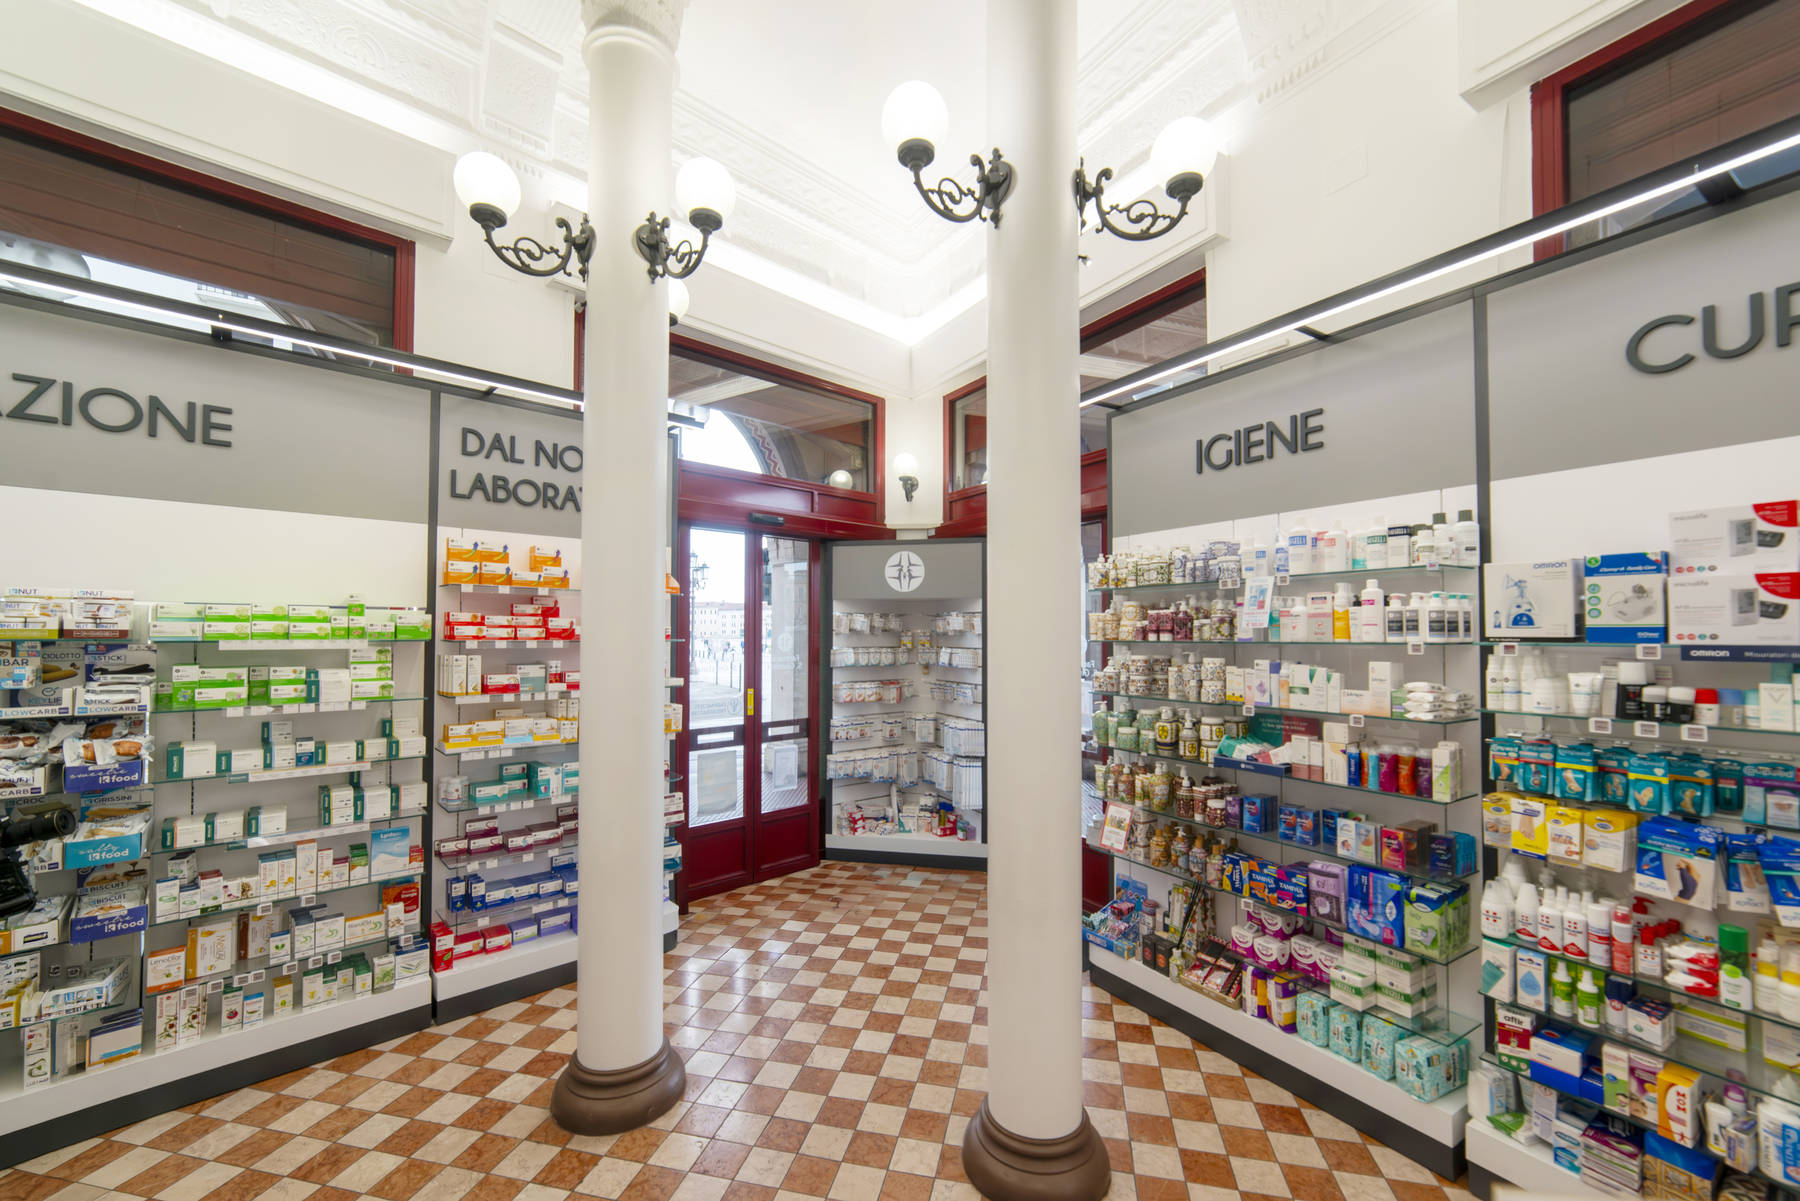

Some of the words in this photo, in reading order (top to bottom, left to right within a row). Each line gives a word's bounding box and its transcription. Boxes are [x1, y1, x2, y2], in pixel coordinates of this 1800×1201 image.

[0, 372, 233, 447] ZIONE
[461, 427, 525, 464] DAL
[535, 440, 583, 472] NO
[1196, 408, 1324, 474] IGIENE
[450, 469, 582, 512] LABORA
[4, 707, 57, 717] LOWCARB
[90, 705, 137, 713] LOWCARB
[1279, 882, 1304, 894] TAMPAX
